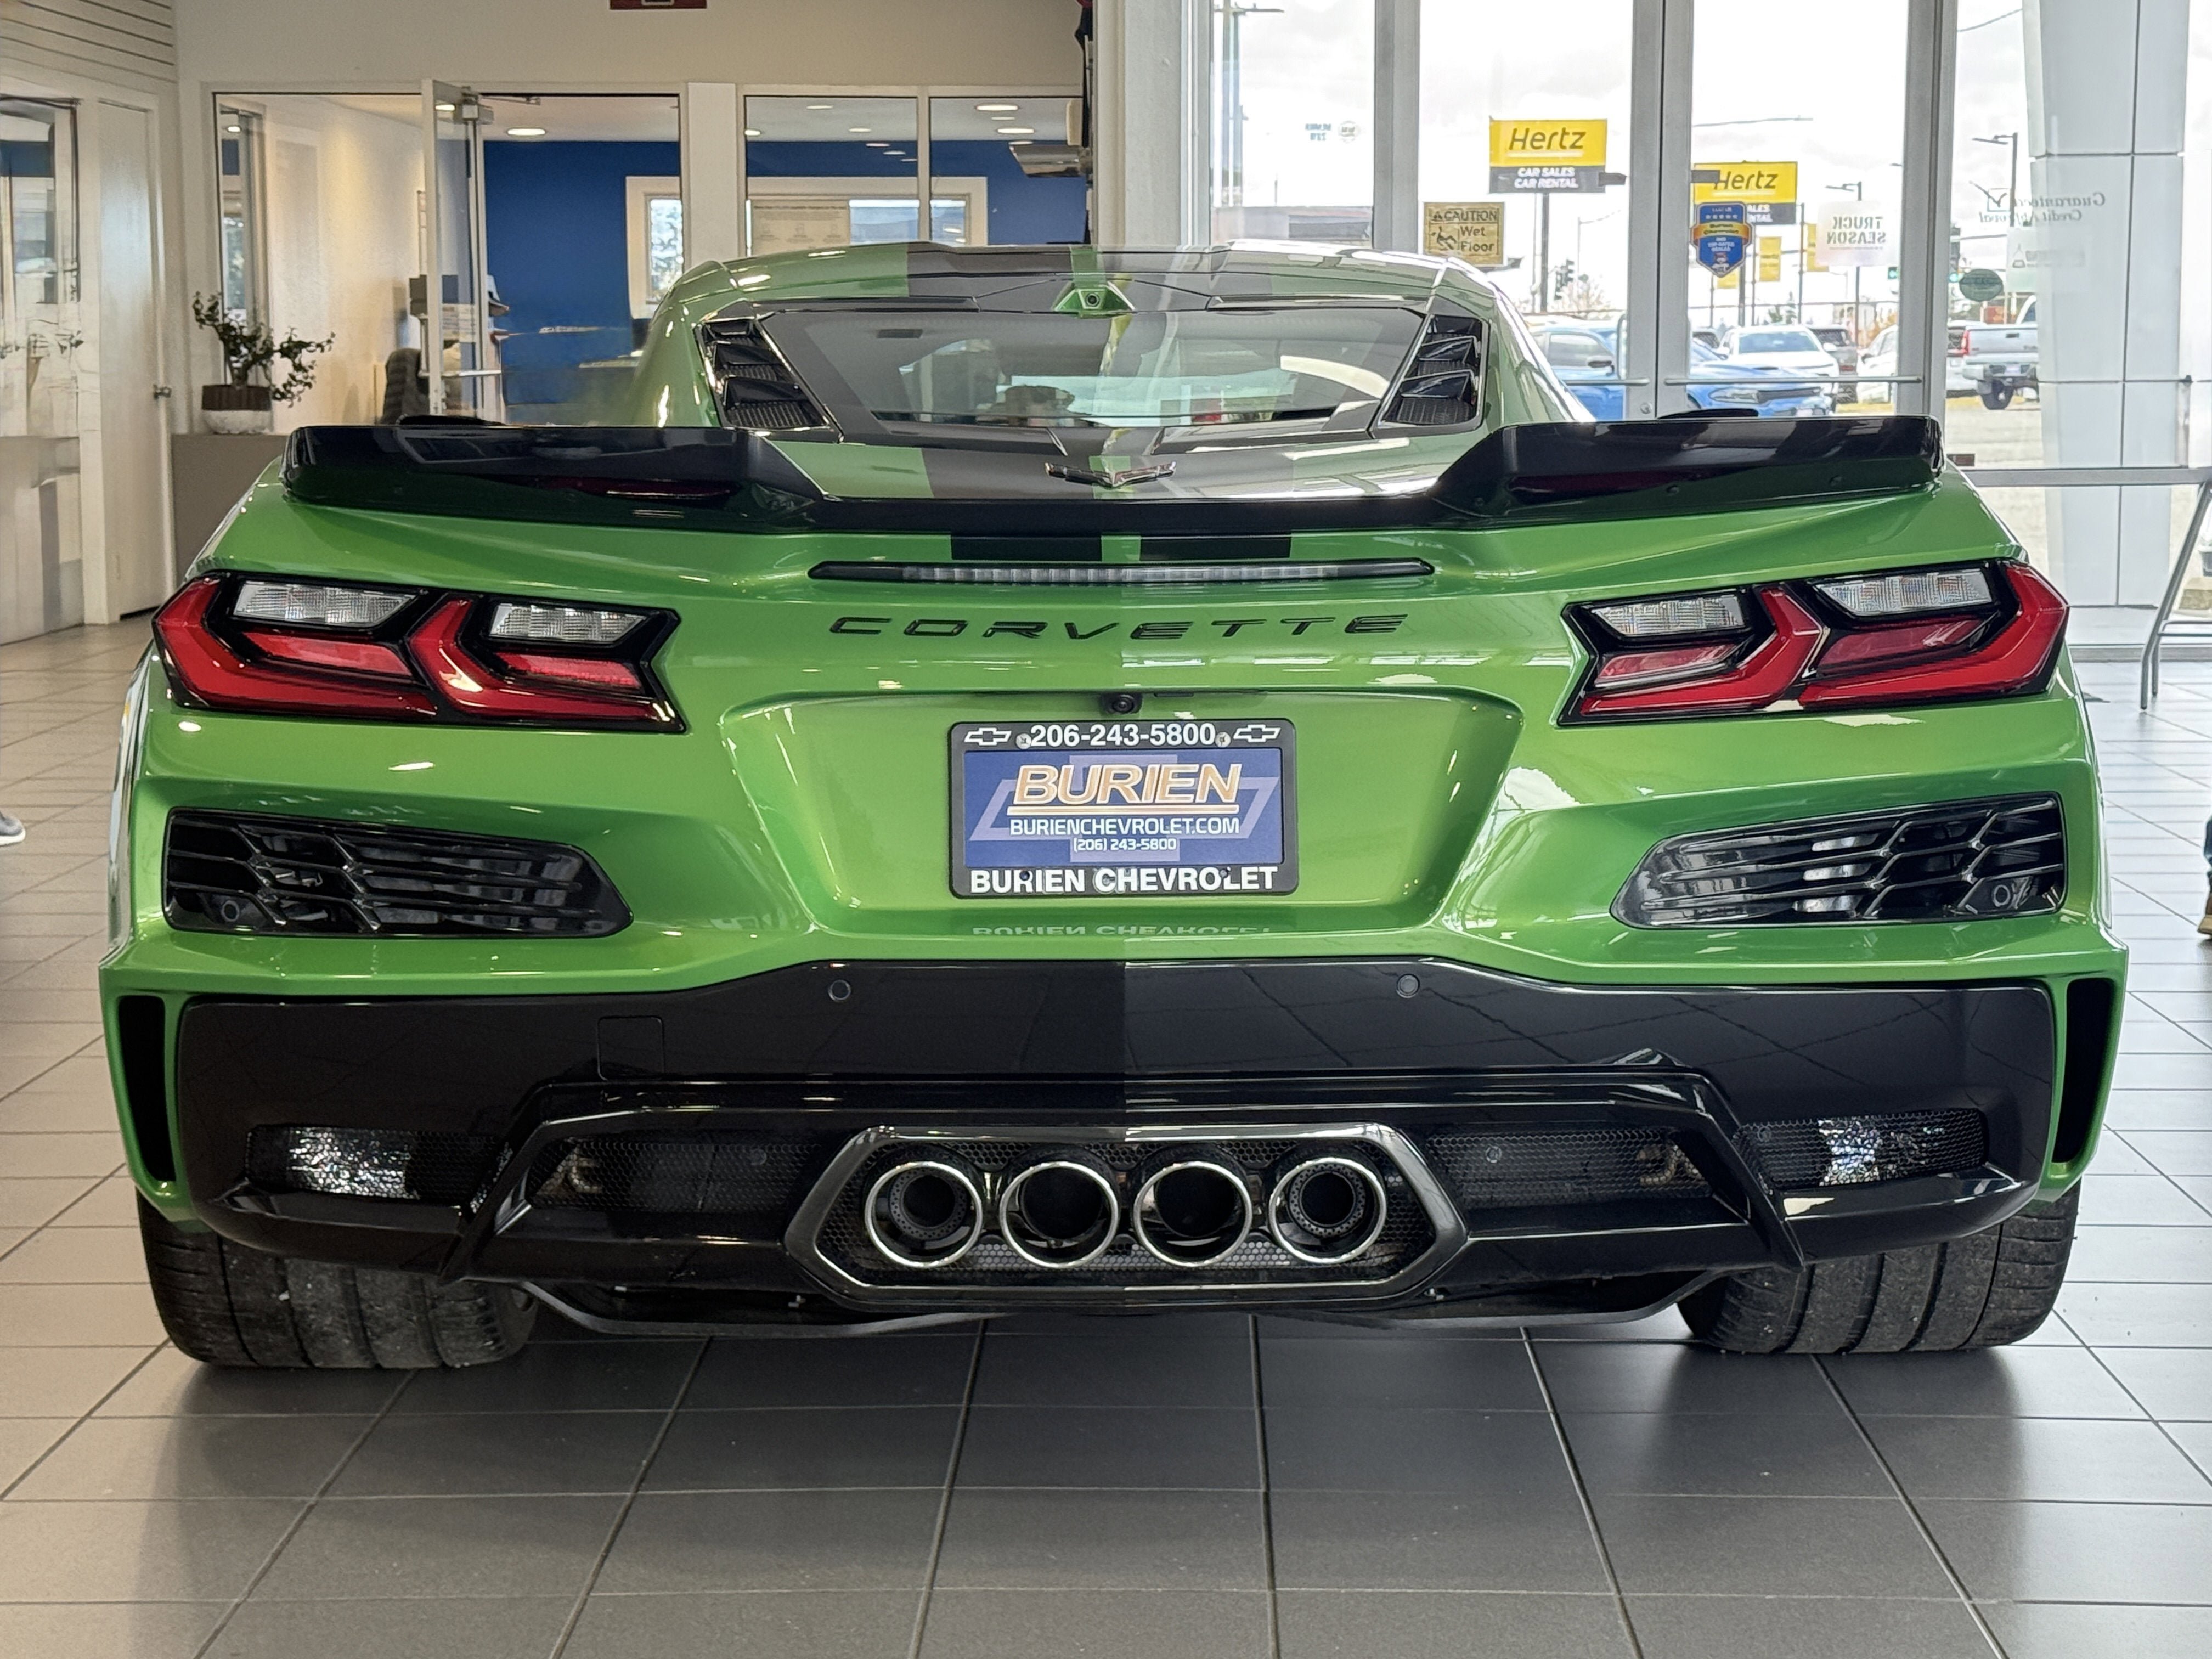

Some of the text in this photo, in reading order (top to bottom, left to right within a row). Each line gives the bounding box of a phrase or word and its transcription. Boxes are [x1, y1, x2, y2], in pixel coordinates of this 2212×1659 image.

[1508, 127, 1587, 150] Hertz
[1517, 167, 1575, 177] CAR SALES
[1714, 170, 1779, 190] Hertz
[1514, 178, 1579, 189] CAR RENTAL
[1444, 210, 1497, 221] CAUTION
[1460, 226, 1486, 236] Wet
[1460, 241, 1495, 252] Floor
[829, 613, 1409, 641] CORVETTE
[1030, 723, 1216, 747] 206-243-5800
[1013, 763, 1243, 805] BURIEN
[1009, 817, 1240, 836] BURIENCHEVROLET.COM
[1074, 837, 1177, 852] (206) 243-5800
[970, 865, 1278, 894] BURIEN CHEVROLET
